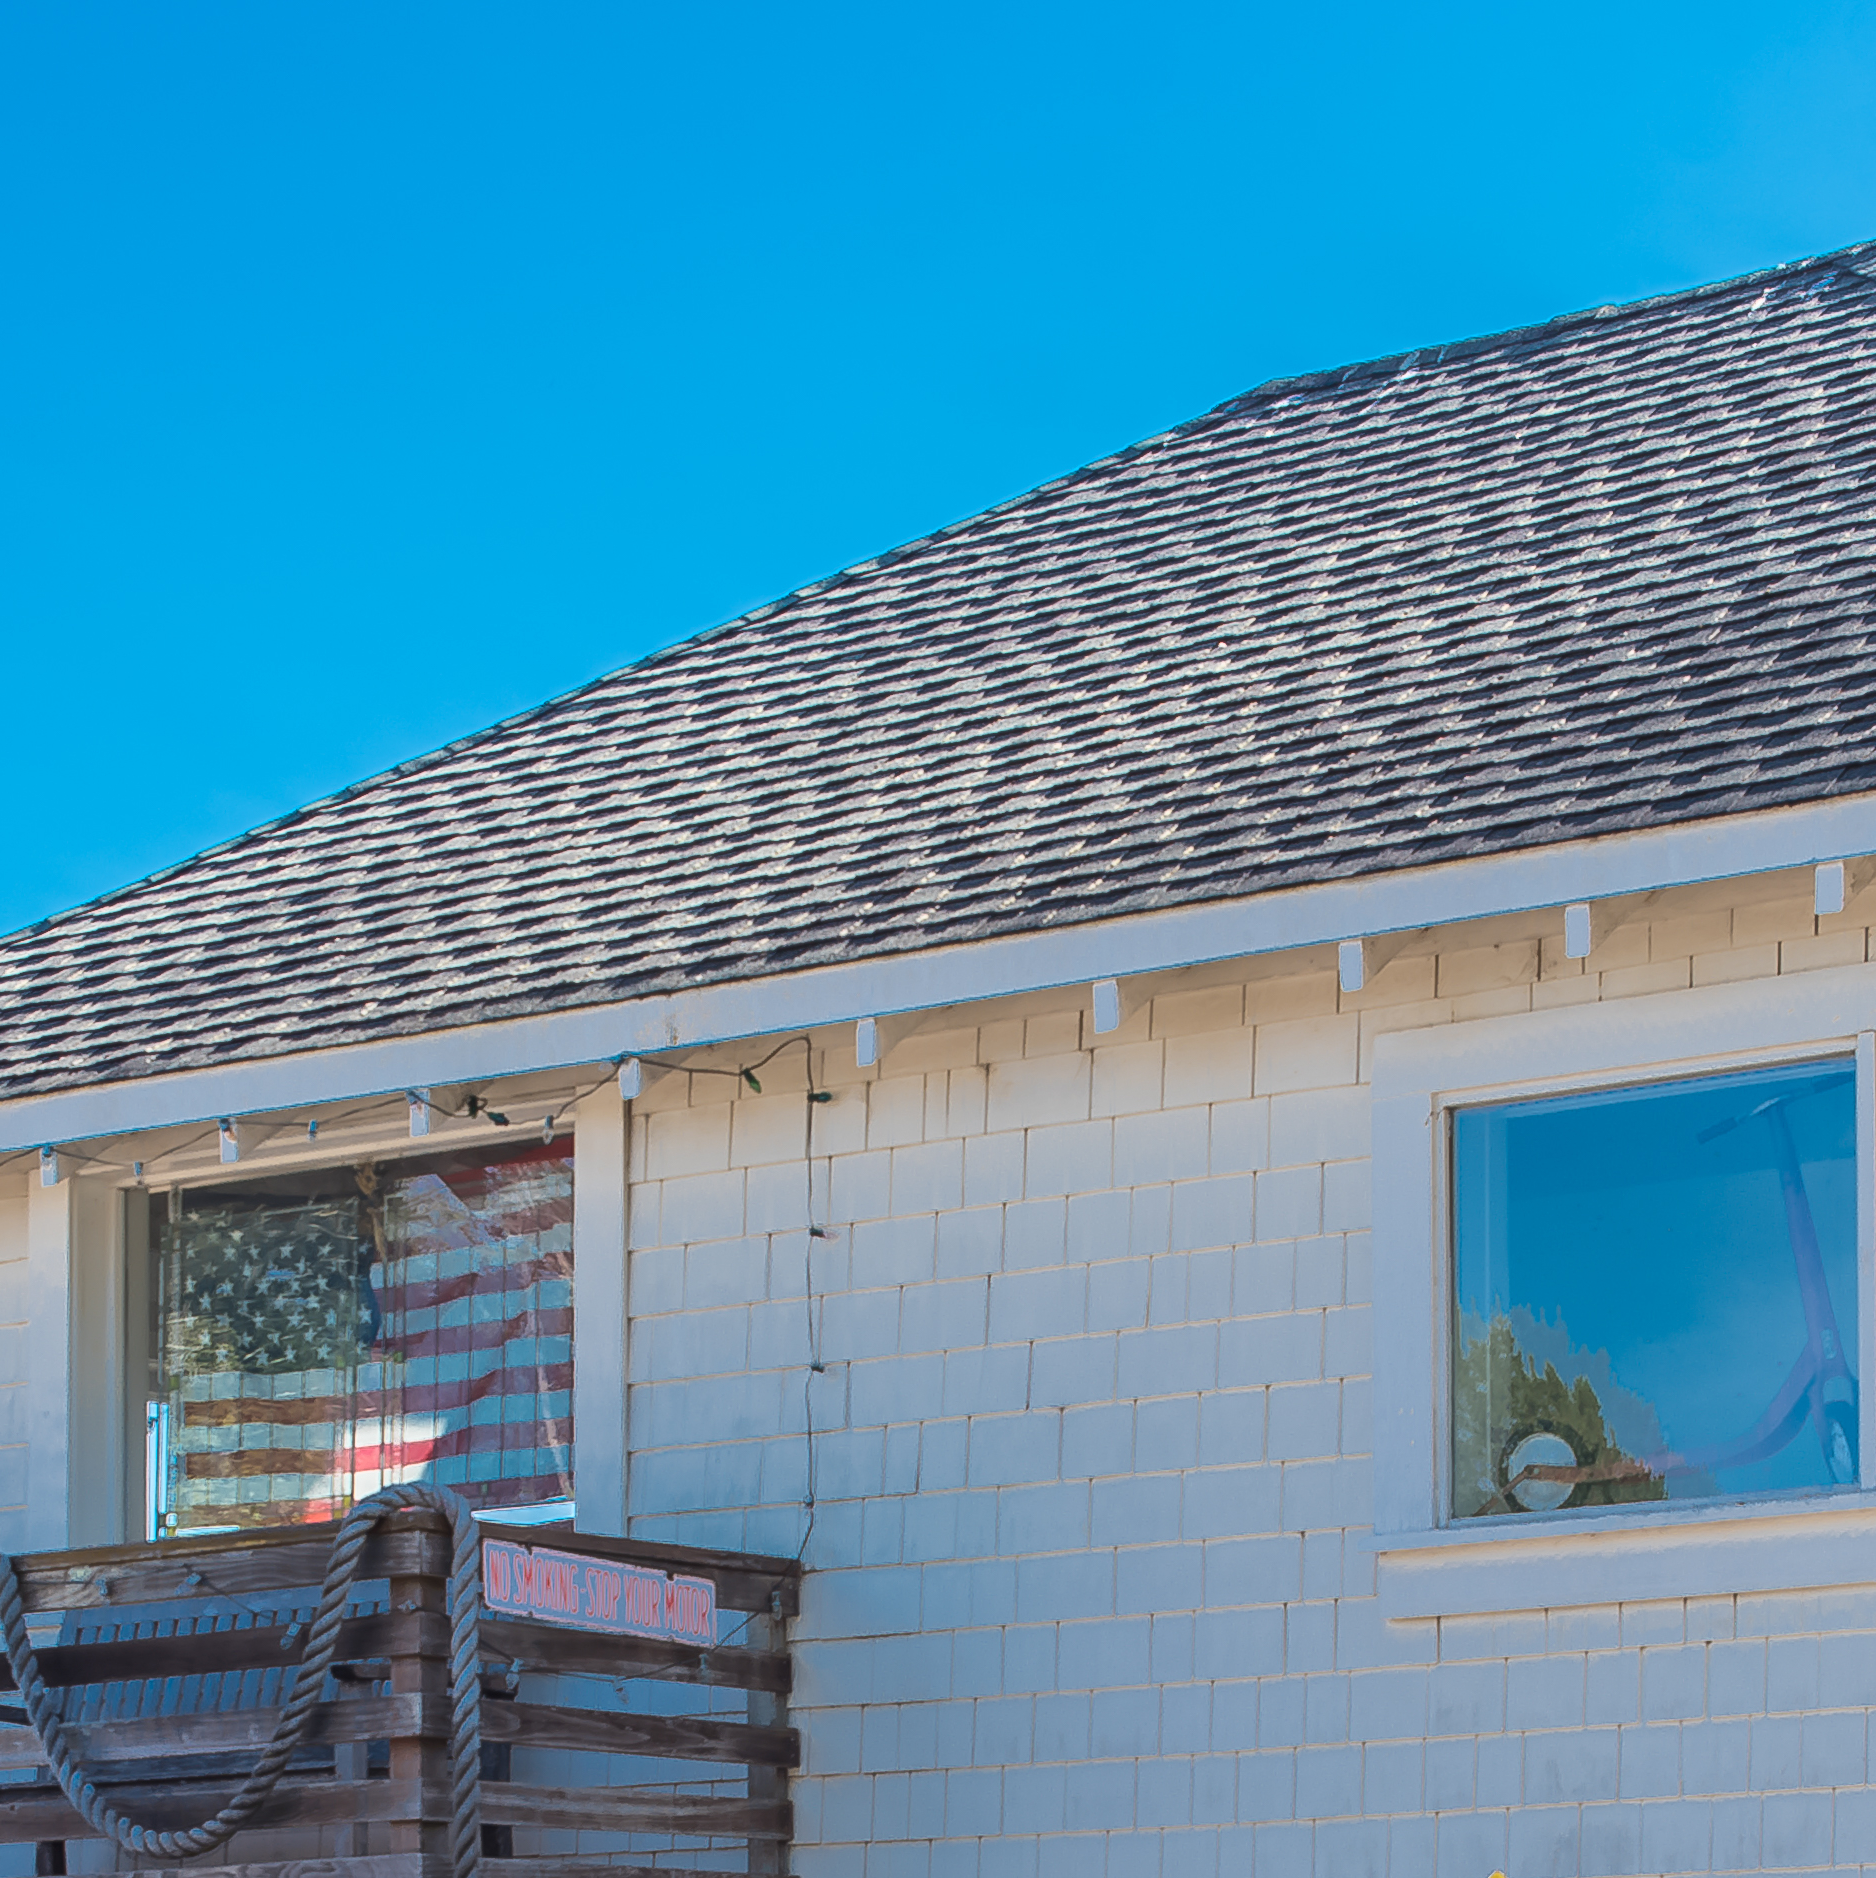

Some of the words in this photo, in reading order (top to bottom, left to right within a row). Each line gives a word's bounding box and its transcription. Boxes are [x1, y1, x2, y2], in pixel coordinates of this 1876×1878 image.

[489, 1550, 511, 1602] NO
[623, 1574, 661, 1628] YOUR
[665, 1582, 711, 1637] MOTOR
